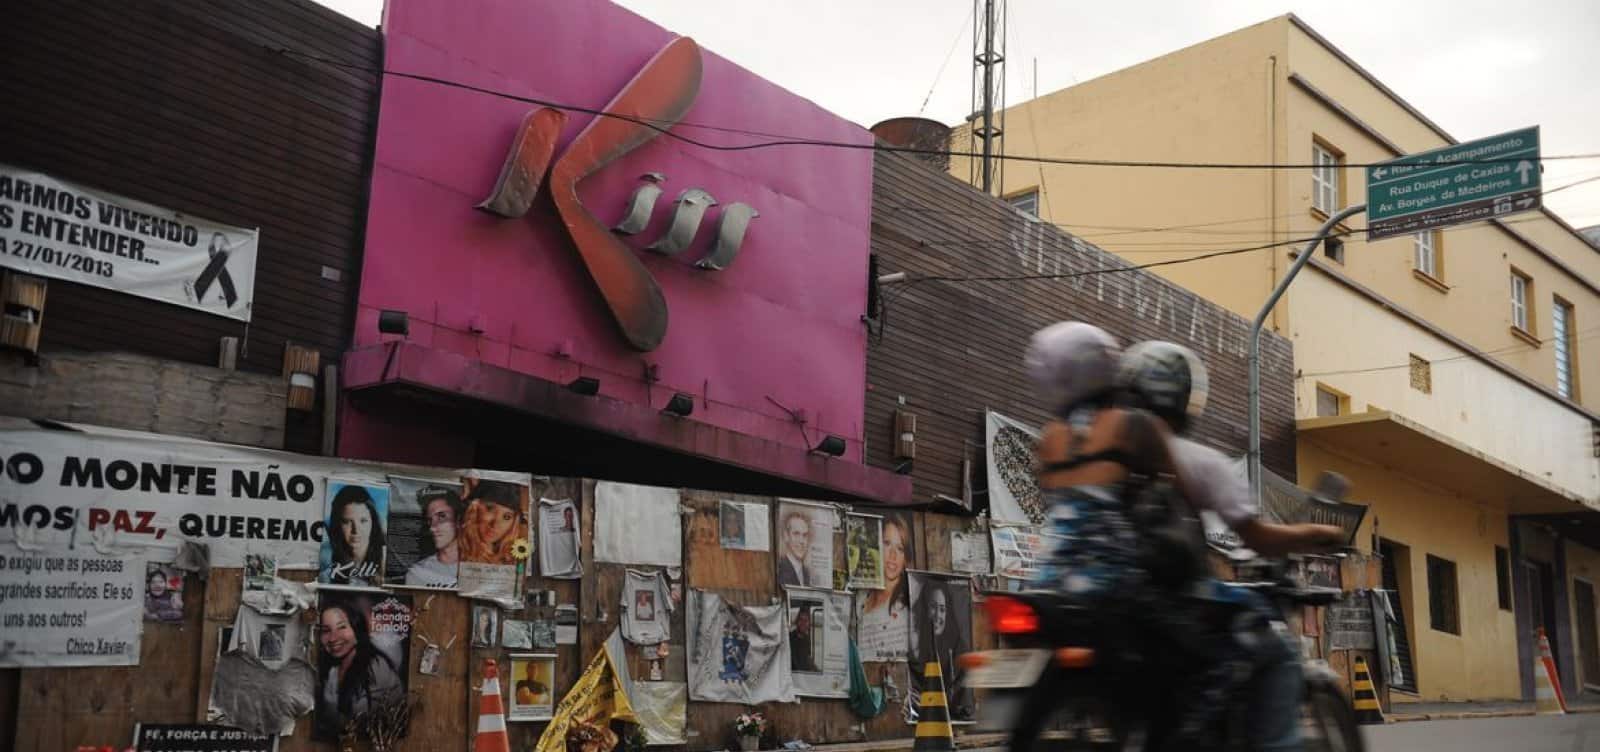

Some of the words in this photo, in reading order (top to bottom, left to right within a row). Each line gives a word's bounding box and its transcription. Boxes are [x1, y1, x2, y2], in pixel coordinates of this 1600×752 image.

[1391, 163, 1412, 175] Rua
[1436, 138, 1523, 164] Acampamento
[1390, 185, 1412, 197] Rua
[1414, 176, 1449, 193] Duque
[1454, 170, 1468, 183] de
[1471, 164, 1511, 179] Caxias
[1398, 194, 1436, 210] Borges
[1441, 190, 1455, 200] de
[1458, 178, 1512, 197] Medeiros
[98, 200, 198, 247] VIVENDO
[20, 210, 160, 265] ENTENDER...
[12, 240, 114, 278] 27/01/2013
[0, 452, 44, 485] O
[60, 456, 217, 496] MONTE
[231, 464, 315, 503] NÃO
[88, 508, 167, 540] PAZ,
[9, 556, 41, 575] exigiu
[45, 557, 64, 575] que
[66, 558, 79, 571] as
[81, 559, 123, 575] pessoas
[331, 561, 379, 579] Kelli
[0, 581, 42, 603] grandes
[103, 582, 119, 600] Ele
[121, 582, 134, 600] só
[4, 613, 25, 627] uns
[27, 613, 47, 627] aos
[49, 610, 87, 627] outros!
[371, 611, 410, 622] Leandra
[371, 620, 409, 632] Toniolo
[66, 638, 95, 655] Chico
[96, 638, 126, 655] Xavier
[167, 729, 208, 741] FORÇA
[210, 730, 218, 740] E
